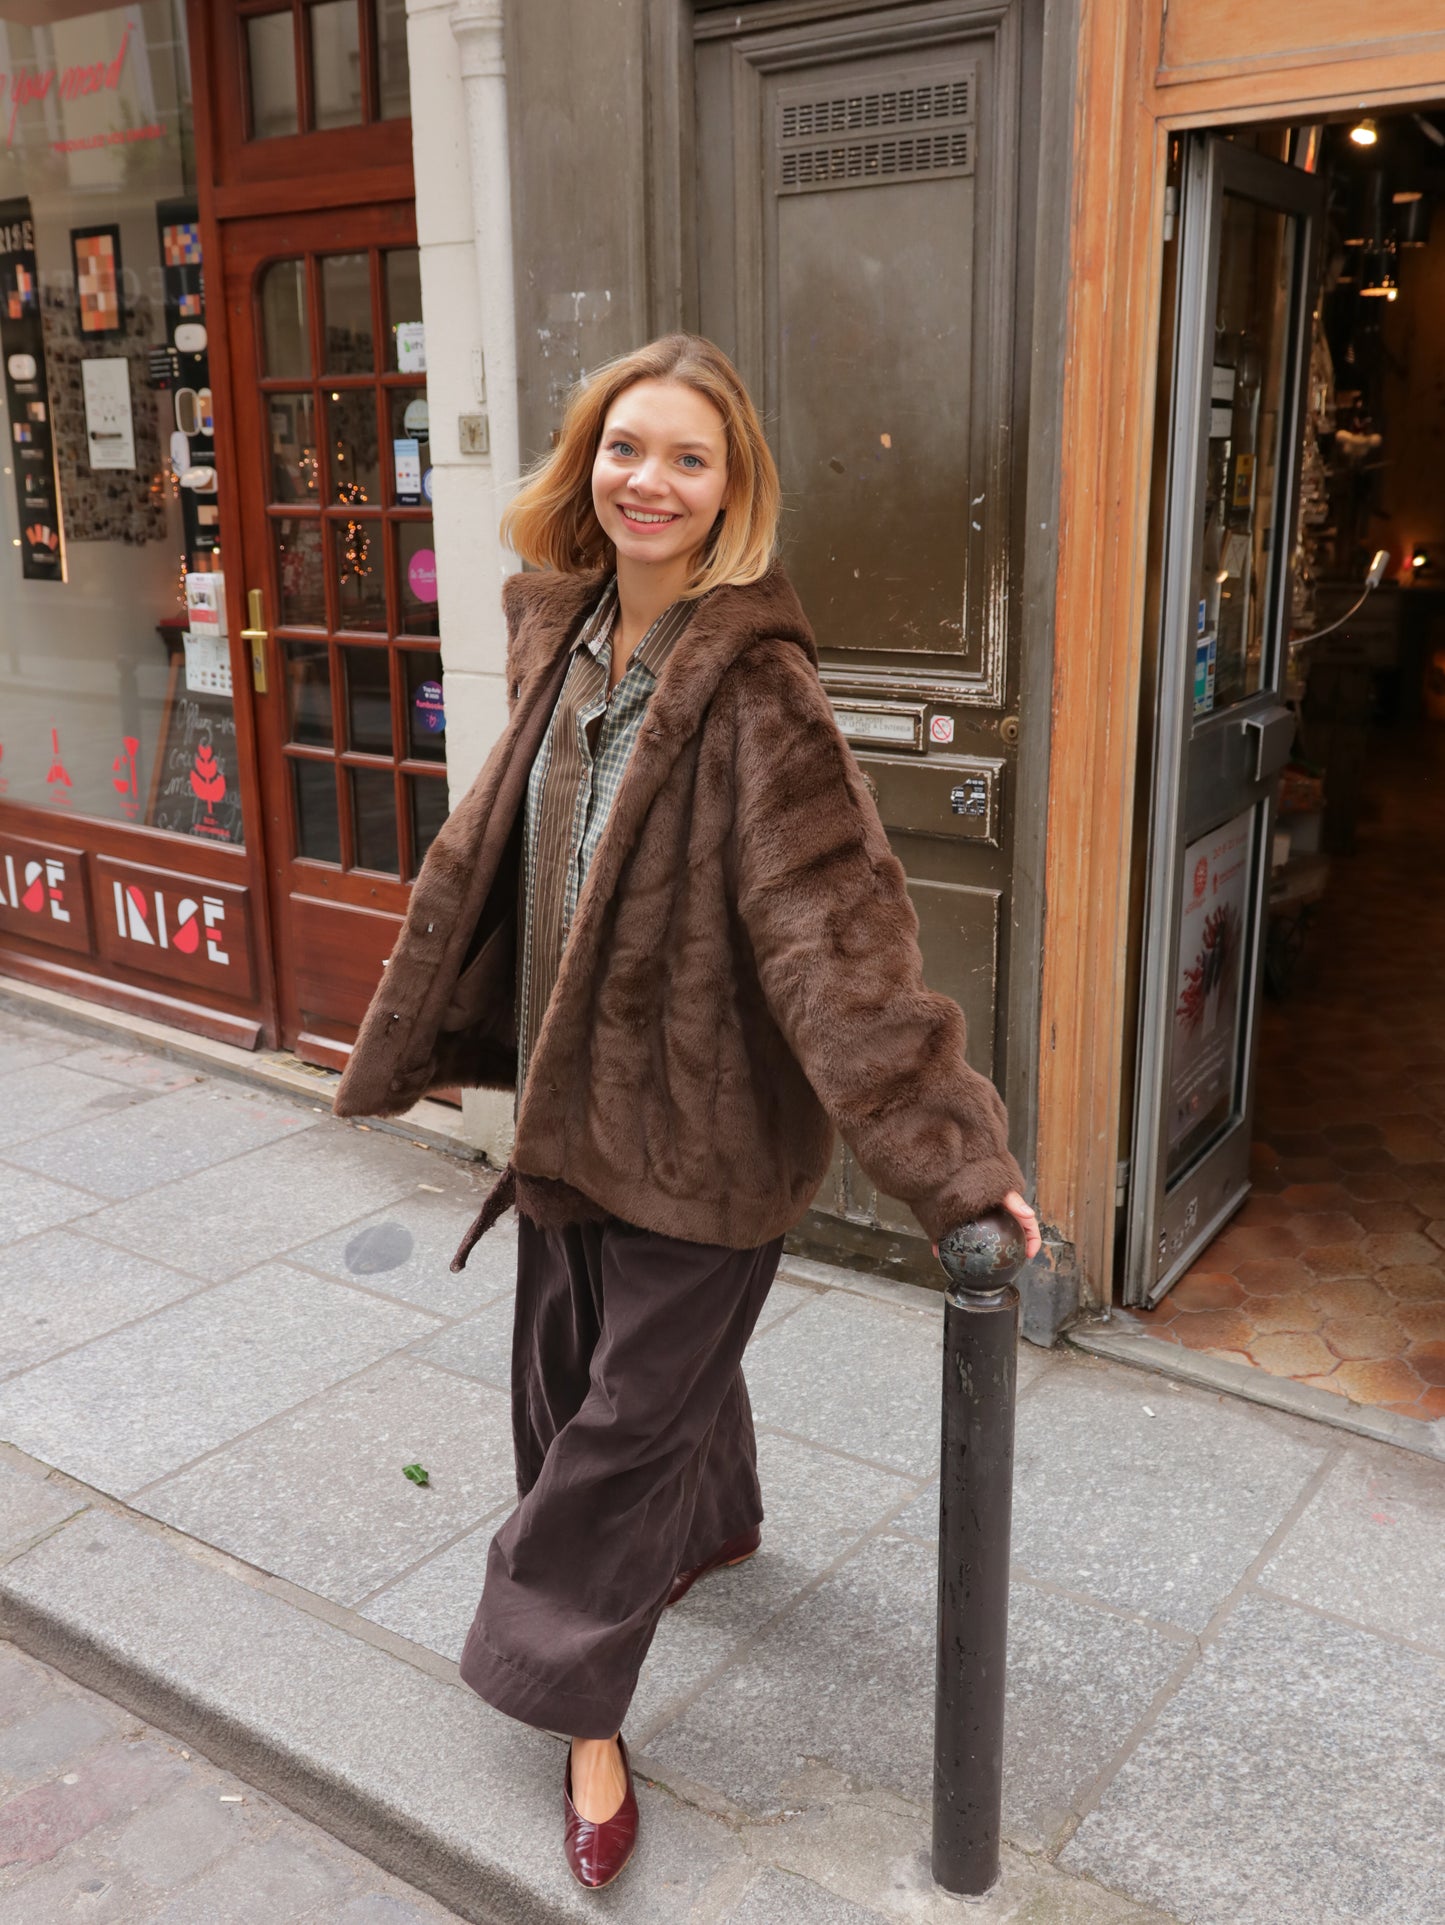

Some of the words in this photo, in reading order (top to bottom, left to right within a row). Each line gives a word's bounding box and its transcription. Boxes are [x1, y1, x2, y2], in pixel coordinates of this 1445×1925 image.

[7, 67, 57, 150] your
[57, 30, 129, 102] mood
[113, 880, 230, 965] RISE
